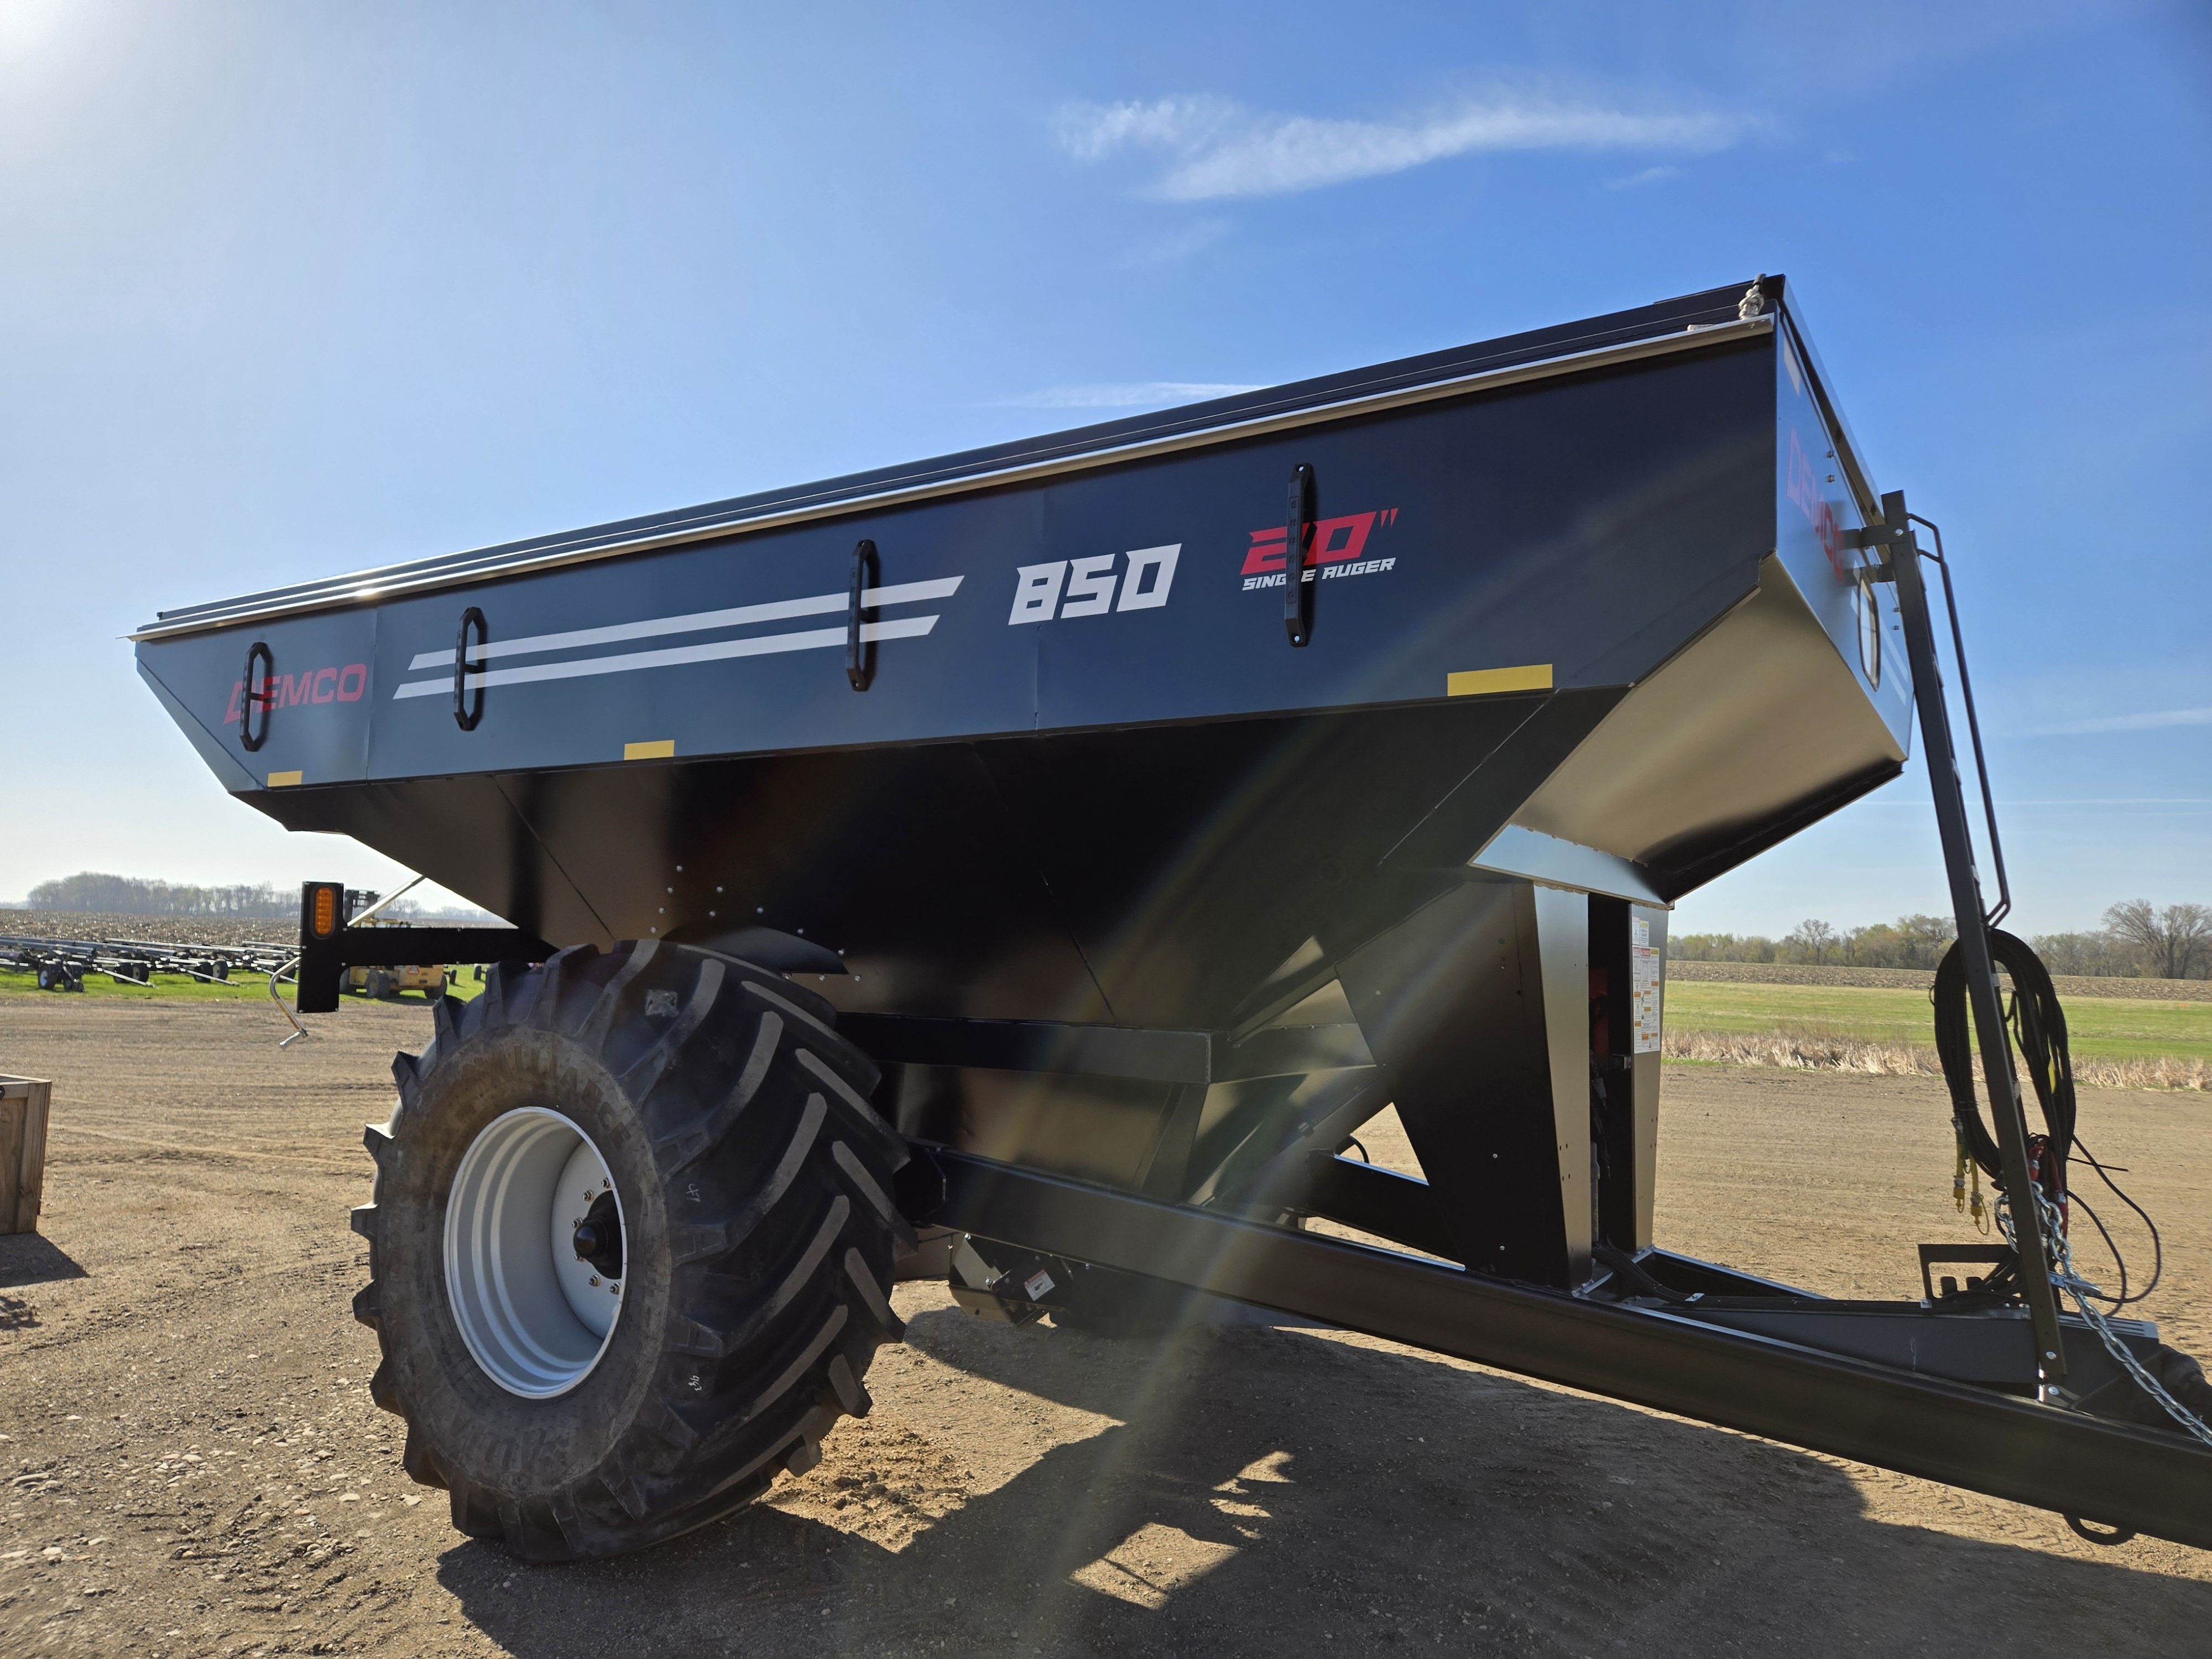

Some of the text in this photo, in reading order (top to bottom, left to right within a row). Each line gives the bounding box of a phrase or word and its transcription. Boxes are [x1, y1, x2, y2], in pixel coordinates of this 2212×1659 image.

[1008, 542, 1182, 625] 850
[1242, 557, 1397, 591] SINGE AUGER
